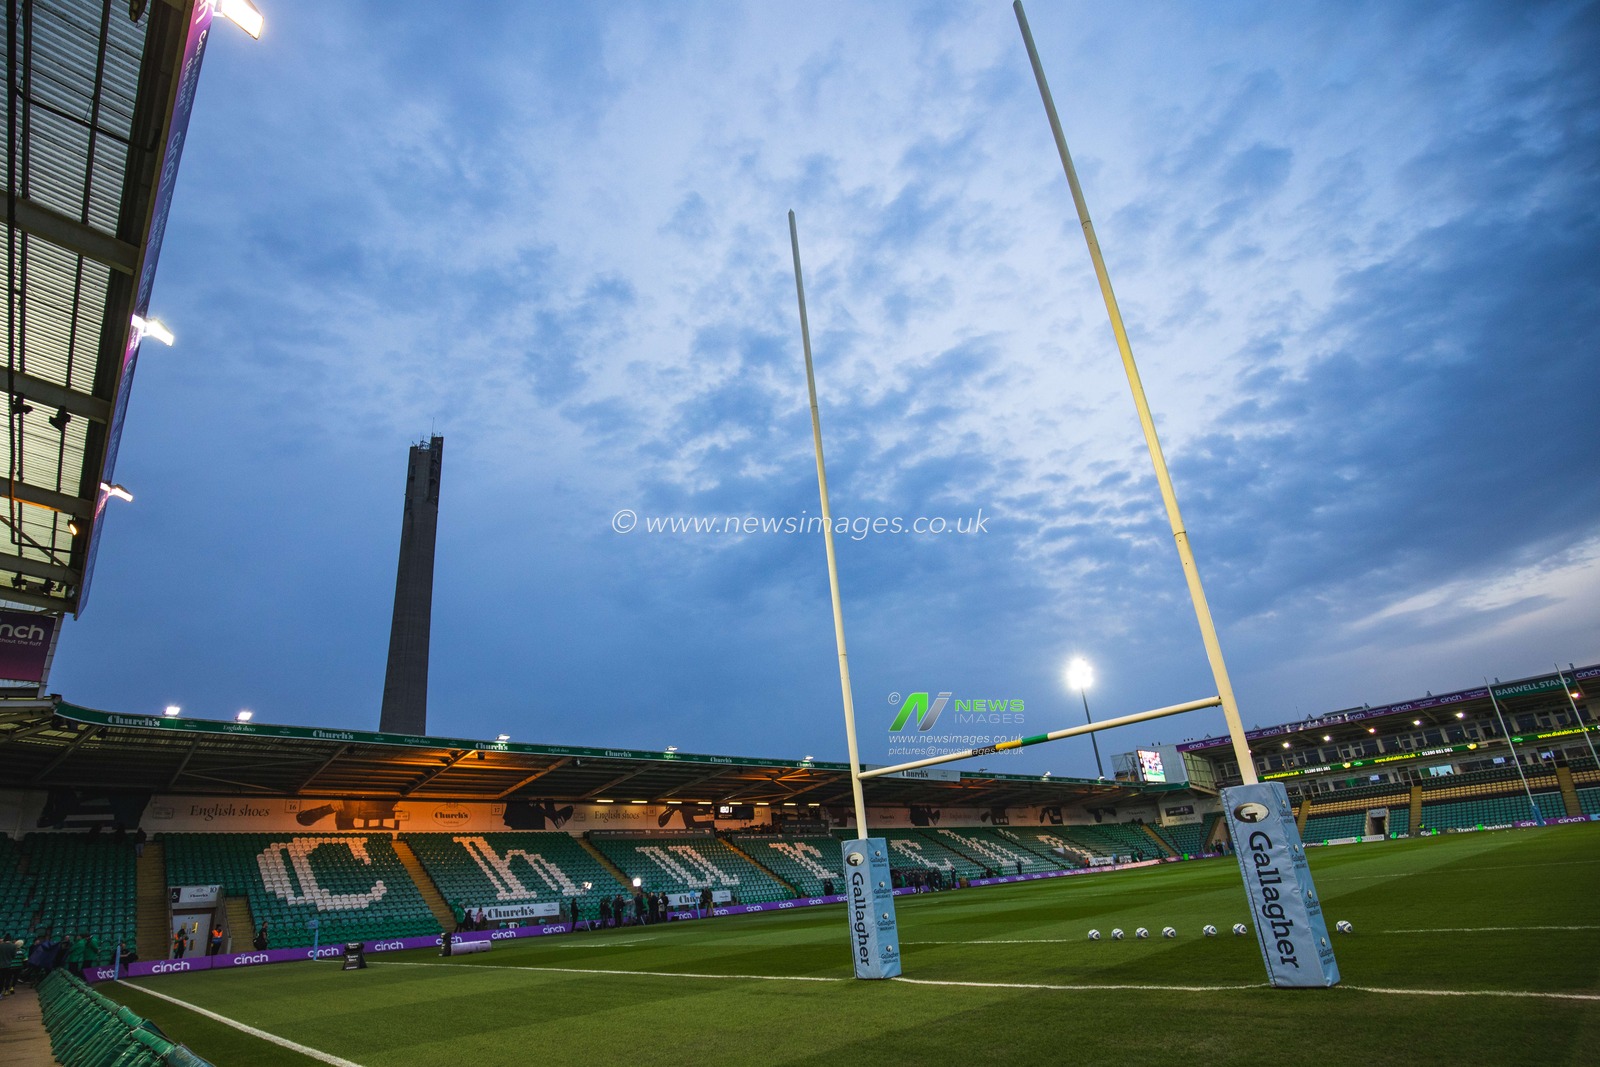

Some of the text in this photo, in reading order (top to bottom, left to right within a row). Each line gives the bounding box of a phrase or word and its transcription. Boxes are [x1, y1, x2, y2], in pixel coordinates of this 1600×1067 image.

[161, 131, 183, 192] cinch
[0, 623, 45, 641] nch
[1576, 668, 1600, 679] cinch
[1495, 677, 1571, 697] BARWELL STAND
[1440, 694, 1462, 704] cinch
[1391, 703, 1412, 713] cinch
[107, 714, 161, 728] Church's
[222, 724, 243, 733] English
[1262, 727, 1280, 736] cinch
[312, 729, 354, 740] Church's
[475, 742, 509, 751] Church's
[1188, 742, 1205, 750] cinch
[604, 750, 632, 758] Church's
[710, 756, 733, 764] Church's
[901, 769, 929, 779] Church's
[190, 803, 270, 821] English shoes
[289, 803, 297, 811] 16
[433, 810, 469, 820] Church's
[594, 808, 640, 824] English shoes
[1557, 816, 1586, 824] cinch
[778, 901, 794, 909] cinch
[1249, 831, 1300, 969] Gallagher
[487, 905, 535, 919] Church's
[746, 904, 763, 912] cinch
[852, 871, 870, 967] Gallagher
[542, 924, 566, 934] cinch
[435, 935, 463, 945] cch
[491, 930, 517, 940] cinch
[374, 940, 404, 951] cinch
[233, 953, 269, 965] cinch
[151, 960, 191, 974] cinch
[96, 967, 115, 980] cinc
